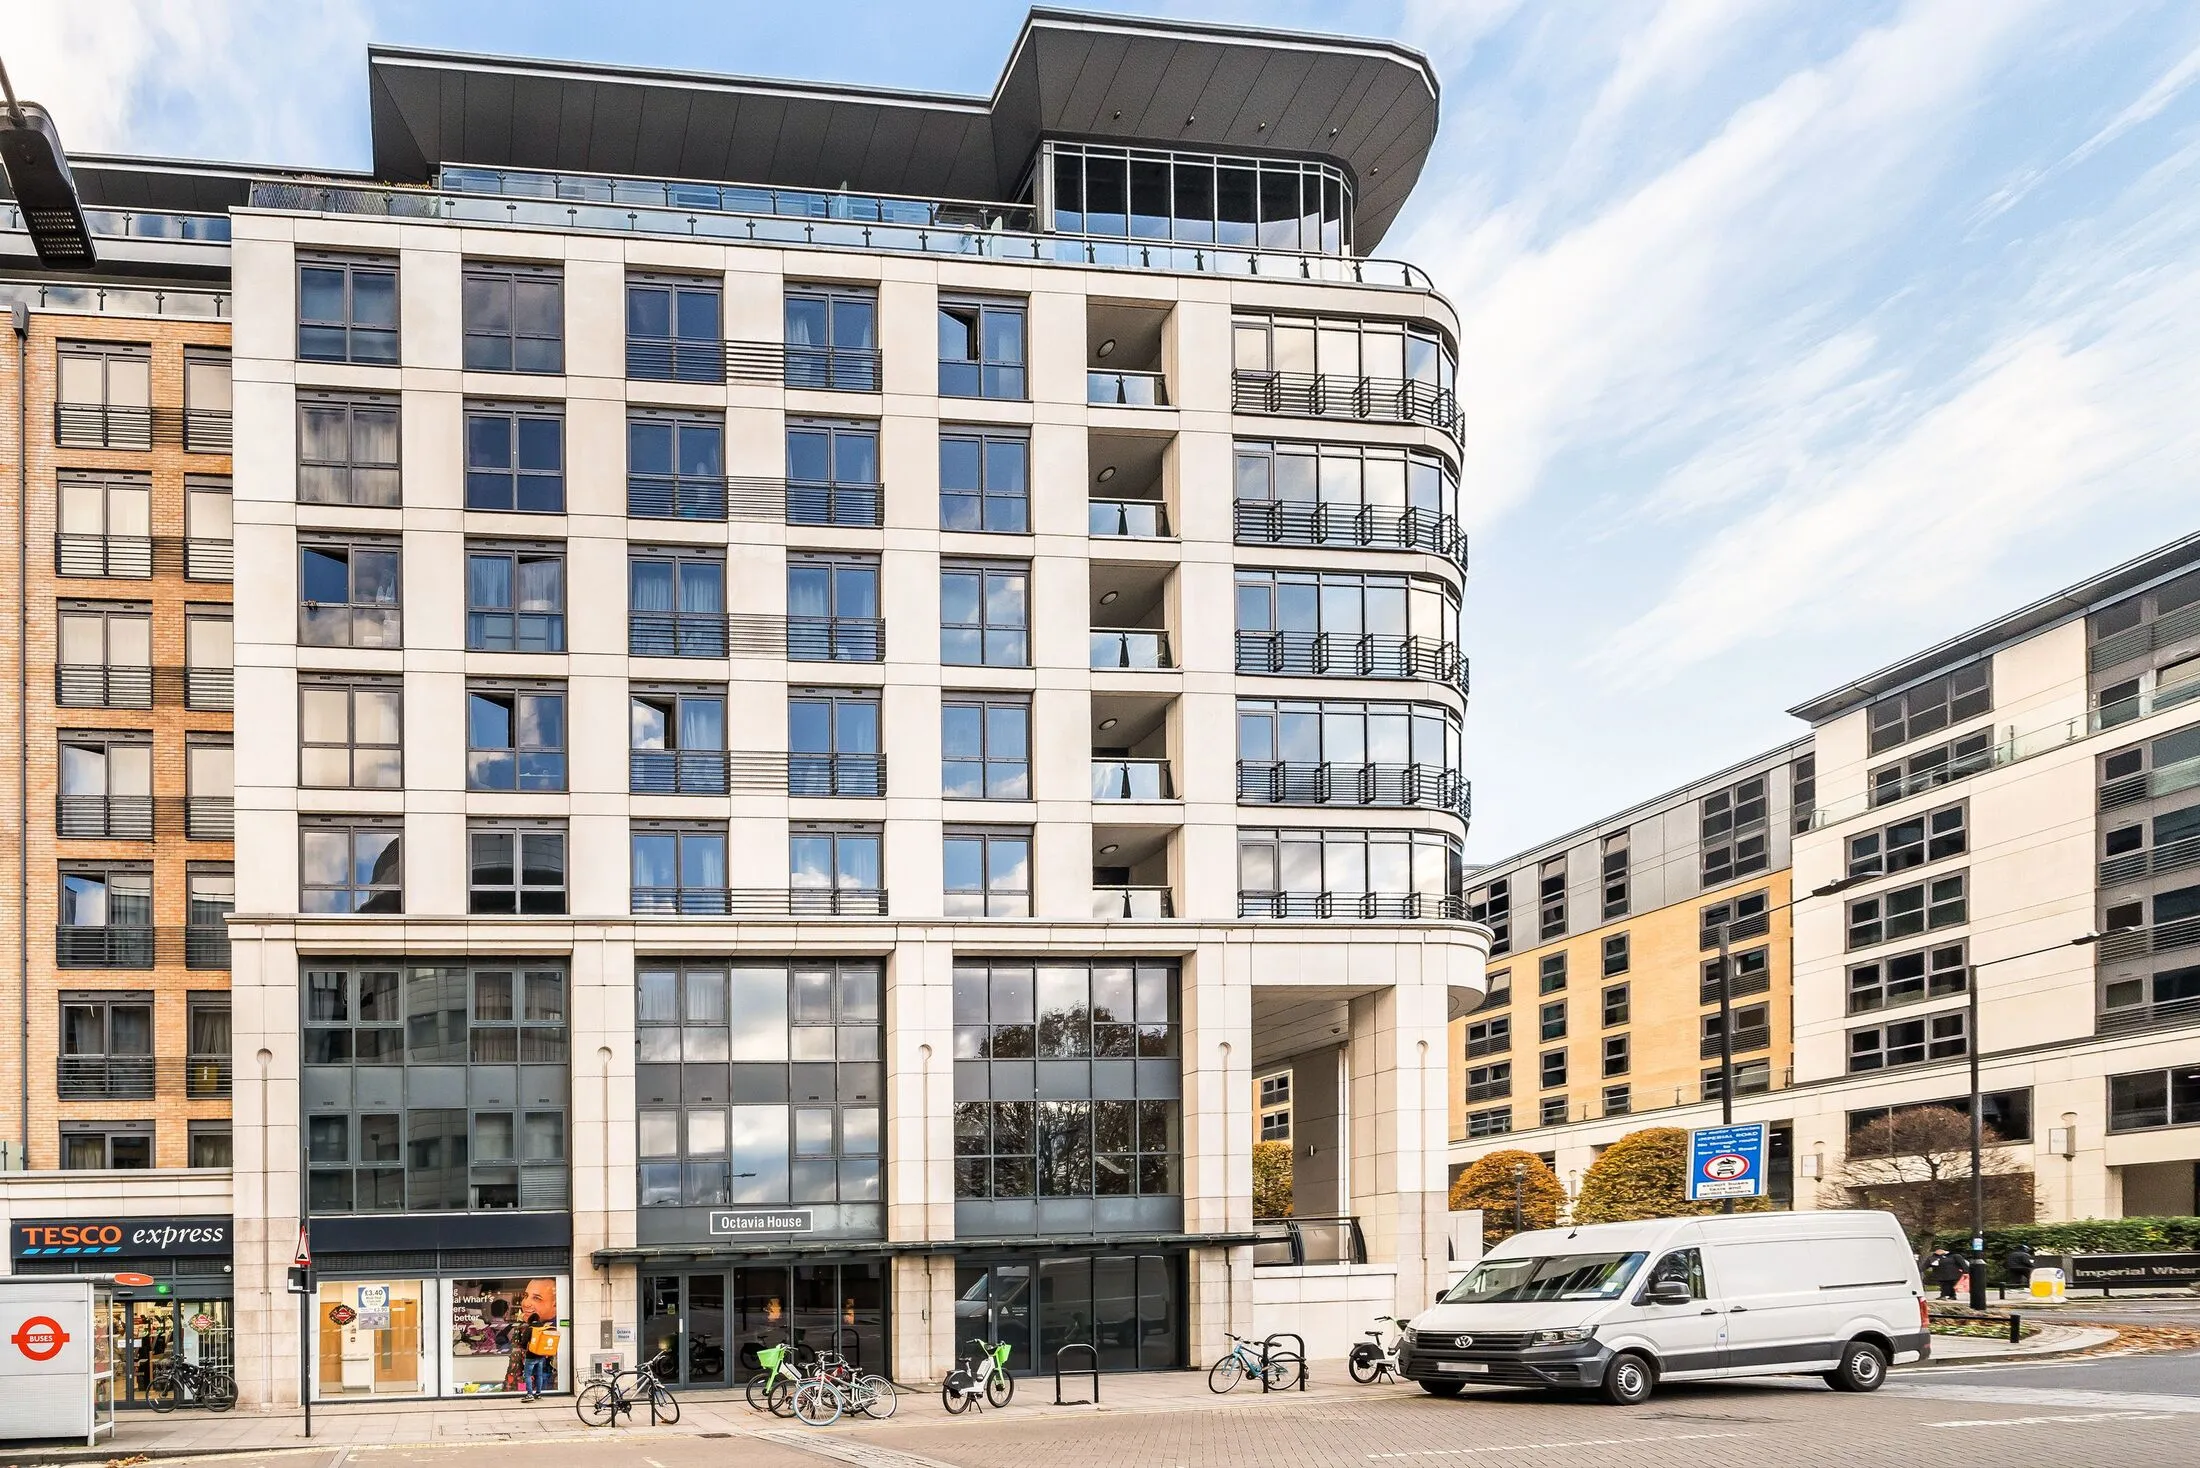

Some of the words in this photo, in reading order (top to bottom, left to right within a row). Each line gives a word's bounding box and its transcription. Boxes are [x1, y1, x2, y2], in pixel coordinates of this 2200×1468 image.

[721, 1216, 764, 1229] Octavia
[767, 1215, 802, 1228] House
[22, 1225, 122, 1246] TESCO
[132, 1225, 224, 1249] express
[2075, 1267, 2145, 1278] Imperial
[462, 1295, 495, 1303] Wharf's
[454, 1314, 480, 1322] better
